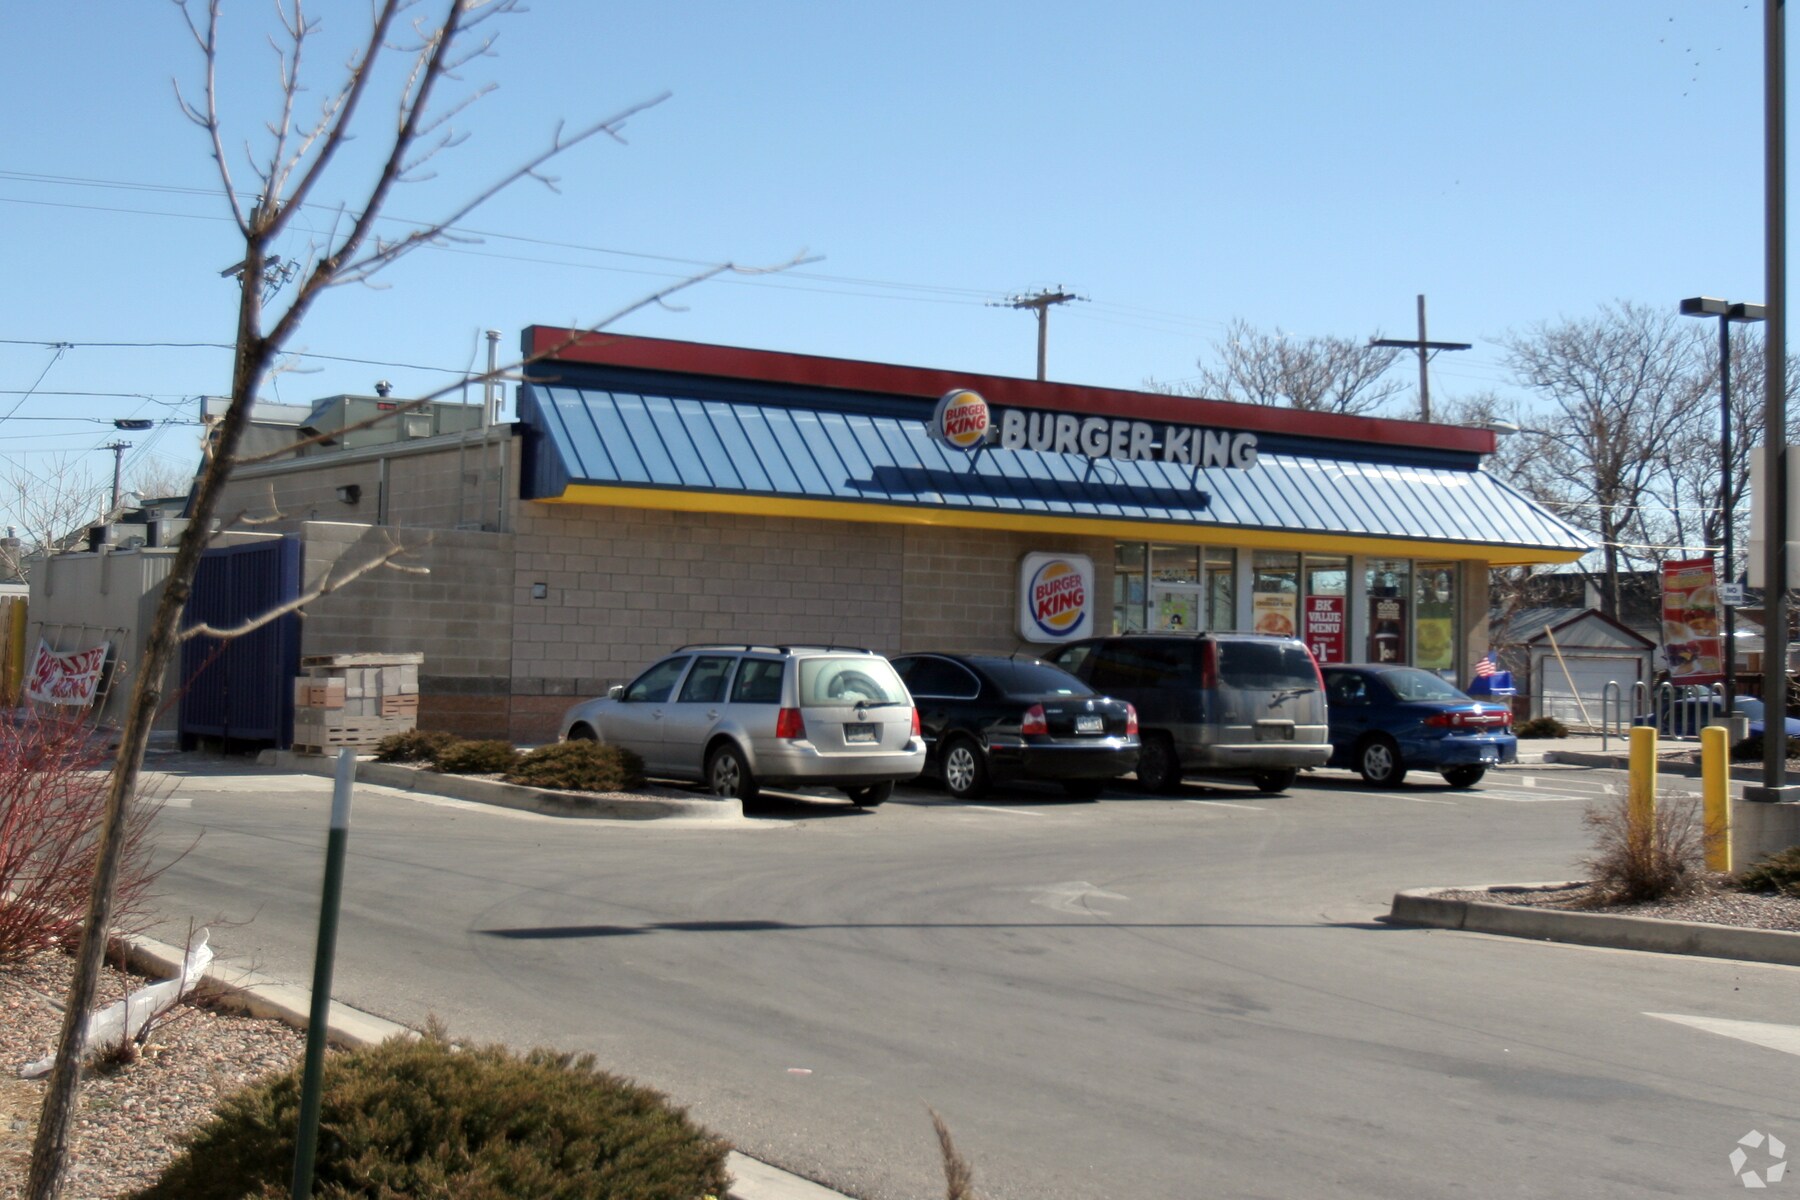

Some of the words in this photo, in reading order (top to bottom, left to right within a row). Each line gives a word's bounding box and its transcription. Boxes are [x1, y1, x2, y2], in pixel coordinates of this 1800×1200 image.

[945, 404, 986, 421] BURGER
[944, 414, 986, 437] KING
[1001, 409, 1154, 460] BURGER
[1164, 425, 1258, 471] KING
[1035, 574, 1083, 601] BURGER
[1037, 587, 1085, 621] KING
[1315, 599, 1335, 611] BK
[1308, 611, 1342, 622] VALUE
[1309, 623, 1341, 634] MENU
